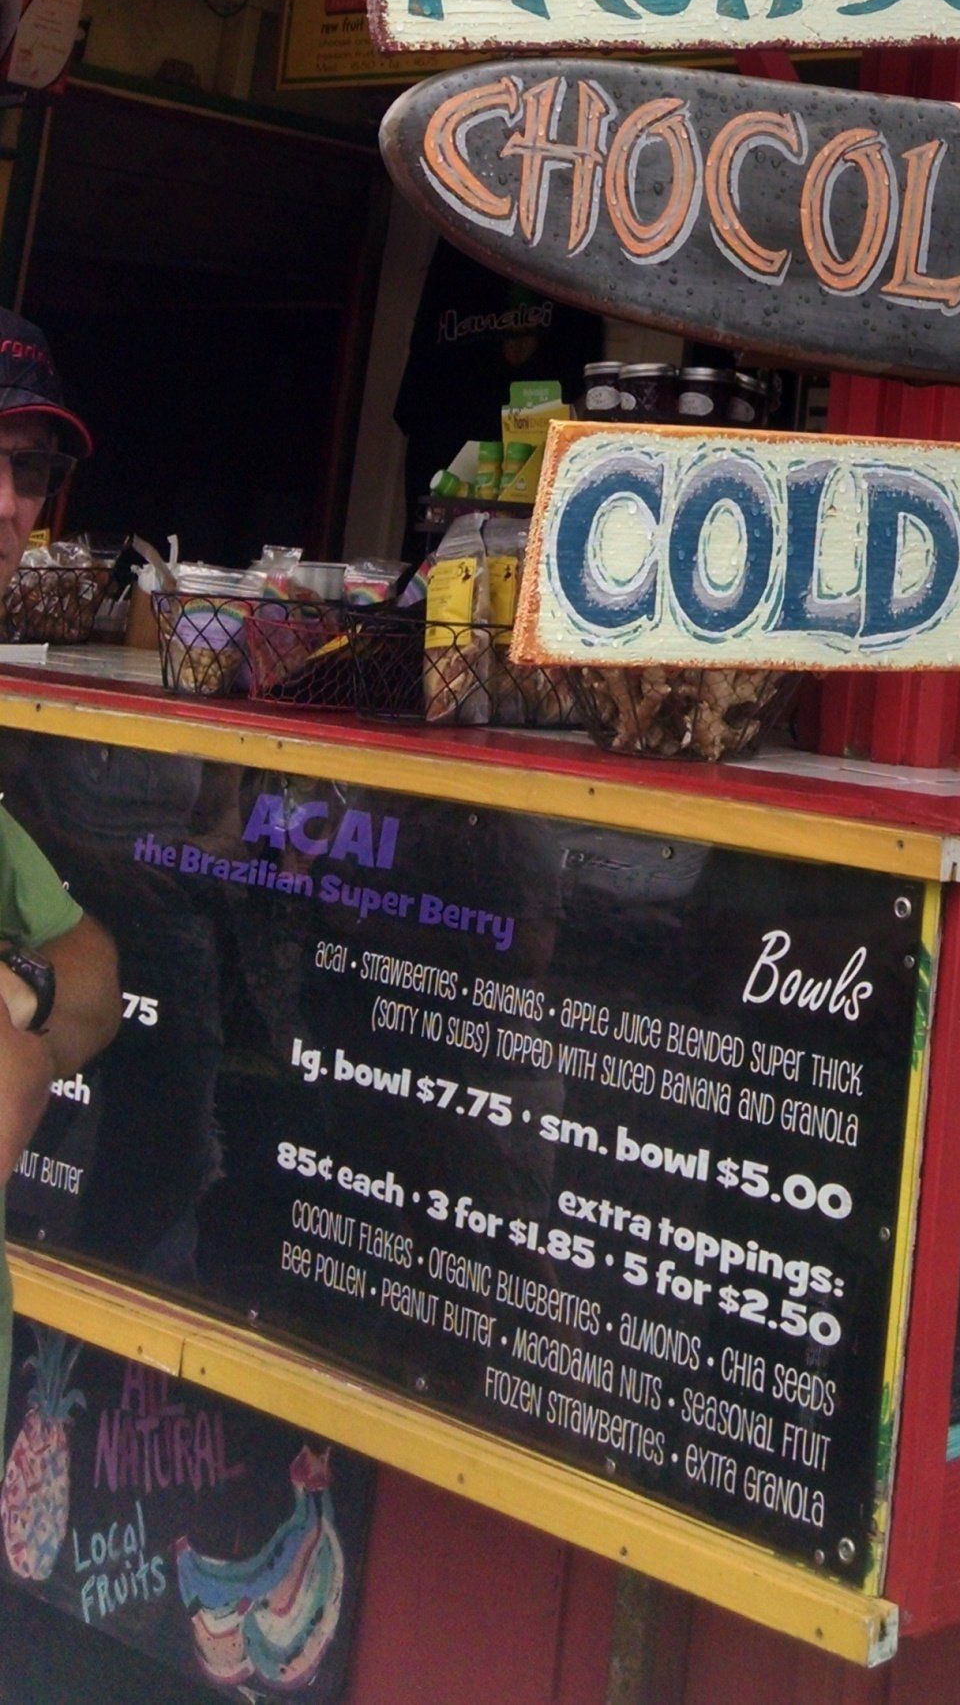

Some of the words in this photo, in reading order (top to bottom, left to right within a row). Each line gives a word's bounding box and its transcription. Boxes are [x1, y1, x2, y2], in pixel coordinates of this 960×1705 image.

[241, 794, 398, 870] ACAI
[133, 833, 175, 867] the
[179, 844, 313, 897] Brazilian
[318, 874, 414, 919] Super
[419, 893, 515, 952] Berry
[741, 929, 873, 1021] Bowls
[421, 1009, 442, 1042] NO
[446, 1016, 491, 1057] SUBS)
[557, 1043, 598, 1081] WITH
[291, 1038, 328, 1082] lg.
[334, 1049, 412, 1097] bowl
[416, 1075, 513, 1127] $7.75
[539, 1113, 608, 1155] sm.
[615, 1125, 710, 1182] bowl
[716, 1157, 853, 1220] $5.00
[336, 1165, 405, 1208] each
[426, 1189, 450, 1221] 3
[454, 1196, 504, 1239] for
[508, 1218, 597, 1270] $1.85
[622, 1250, 649, 1287] 5
[655, 1259, 712, 1306] for
[717, 1284, 842, 1346] $2.50
[558, 1190, 652, 1241] extra
[657, 1217, 845, 1298] toppings:
[619, 1366, 663, 1412] NUTS
[93, 1408, 250, 1494] NATURAL
